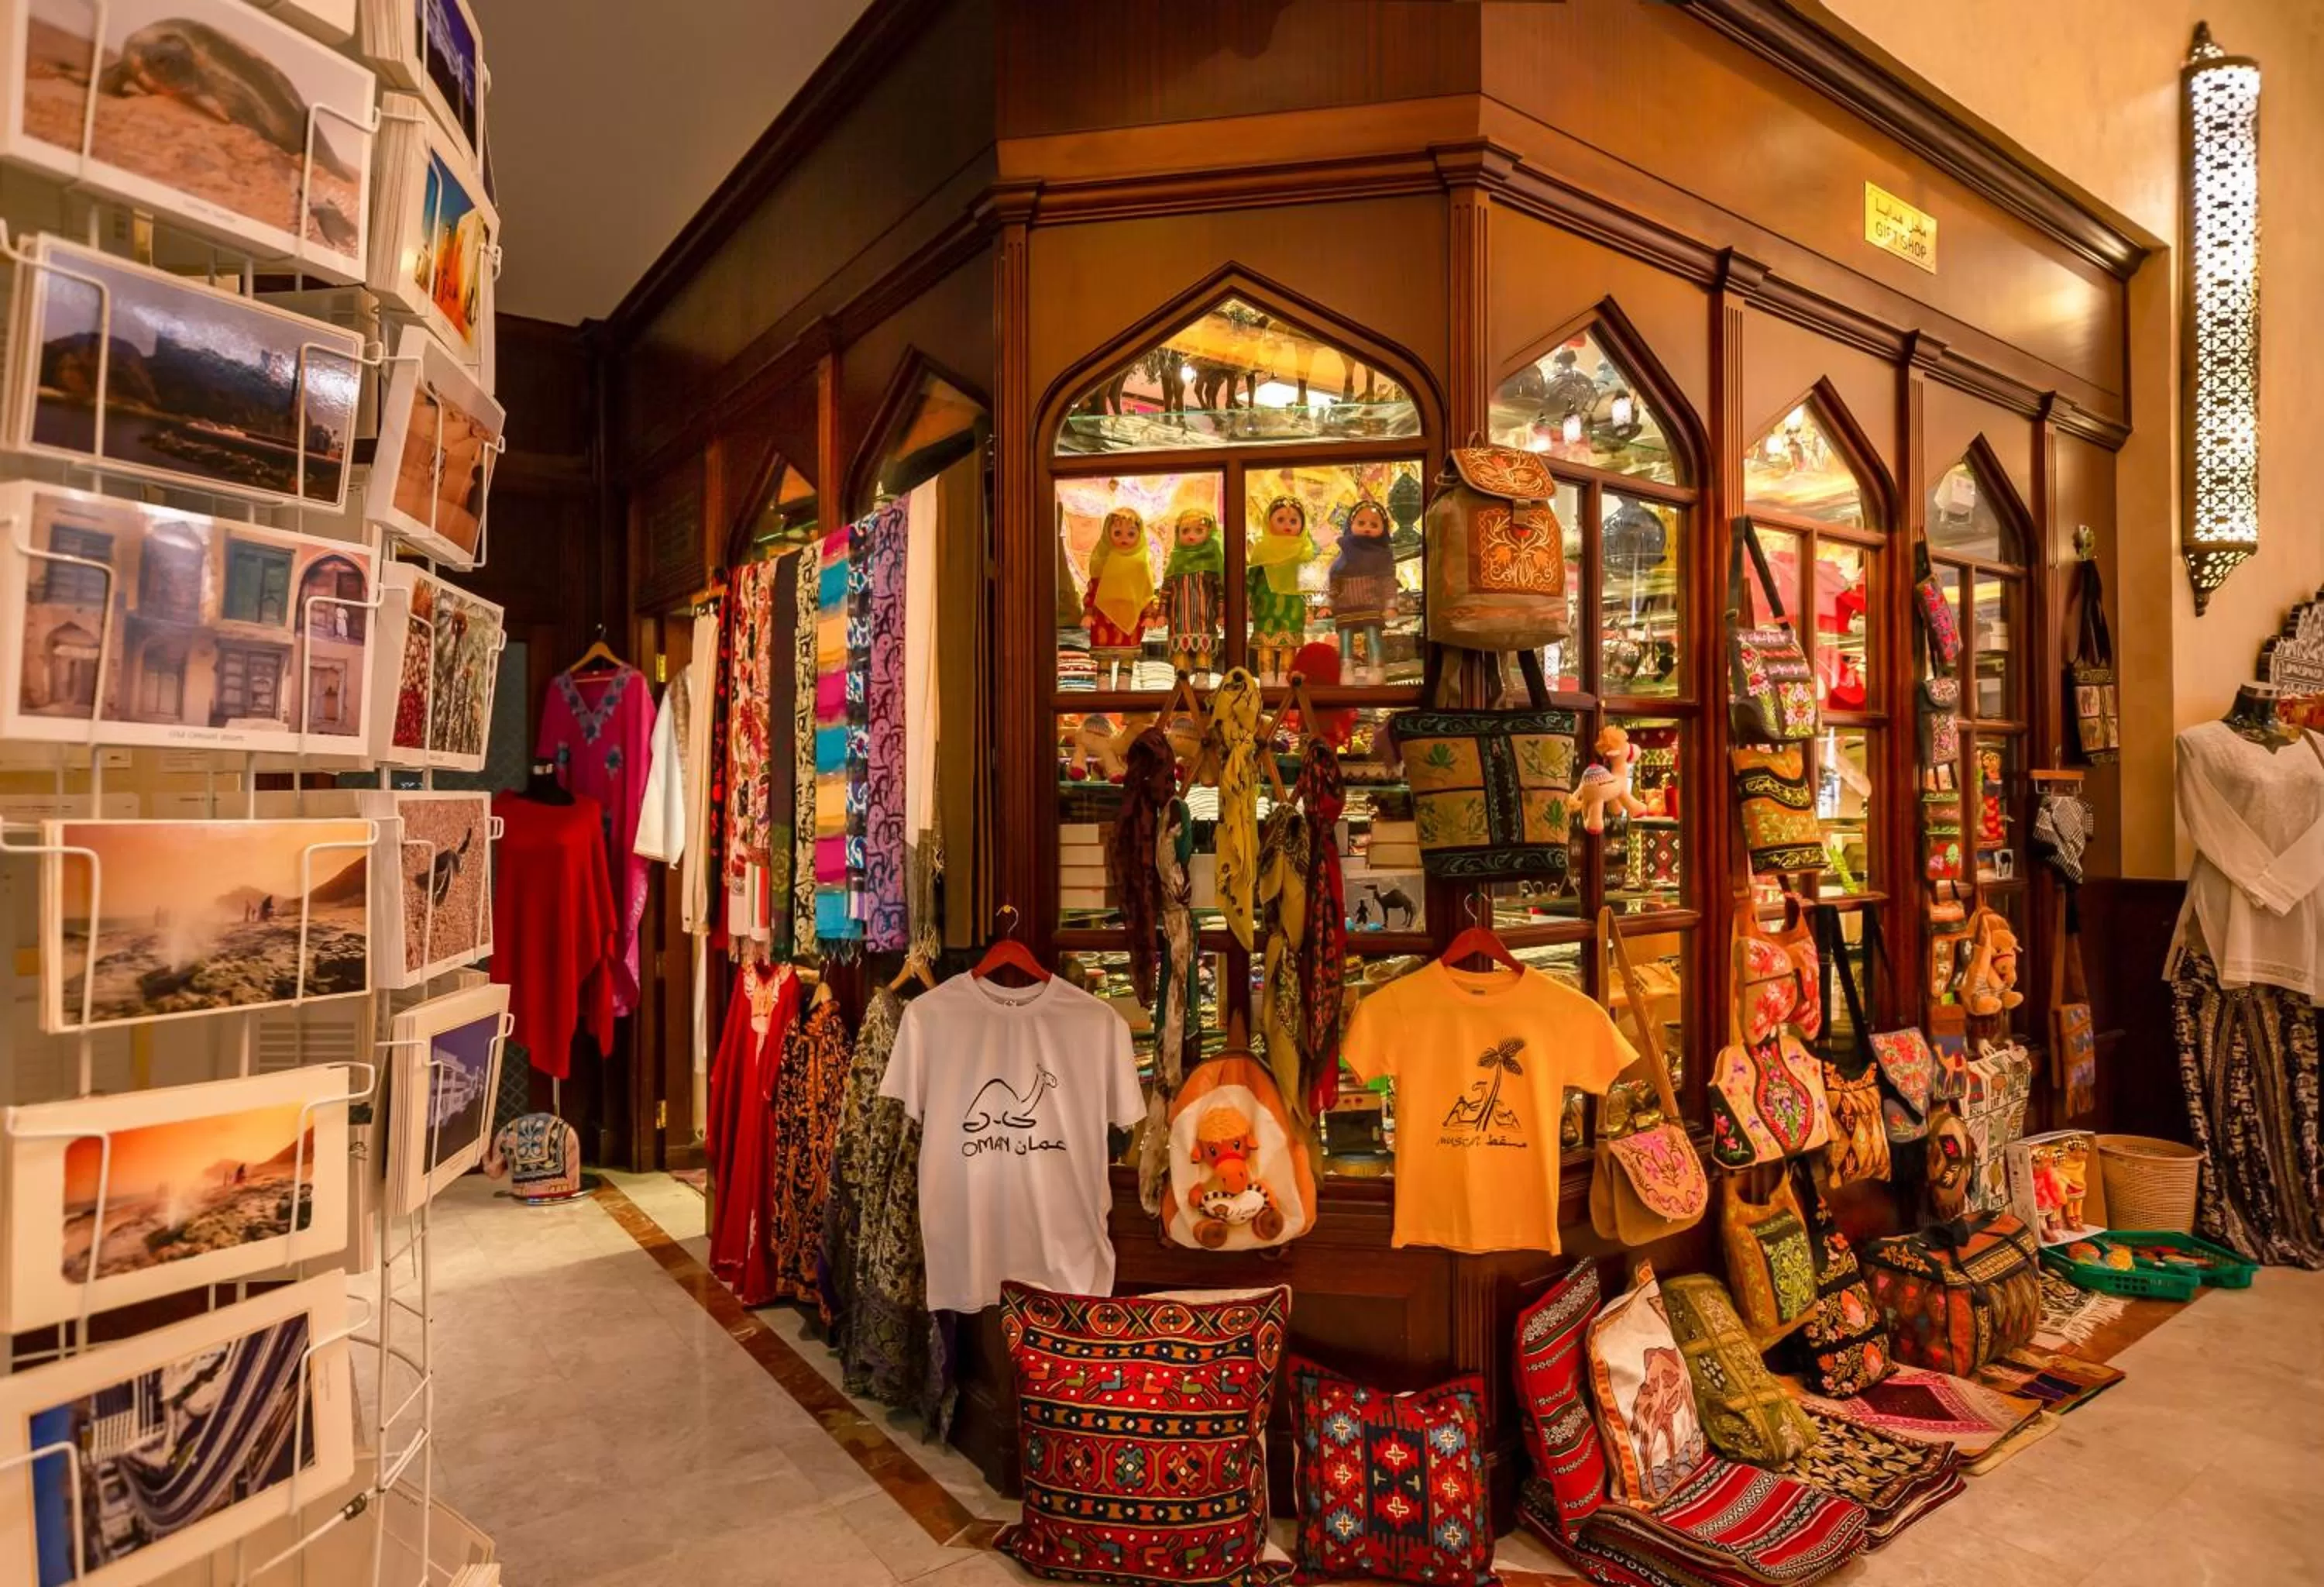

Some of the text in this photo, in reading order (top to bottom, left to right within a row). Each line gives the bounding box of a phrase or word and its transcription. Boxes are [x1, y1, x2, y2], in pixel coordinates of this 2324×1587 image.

[1875, 221, 1927, 259] GIFT SHOP
[961, 1136, 1010, 1157] OMAN
[1015, 1134, 1067, 1155] عمان
